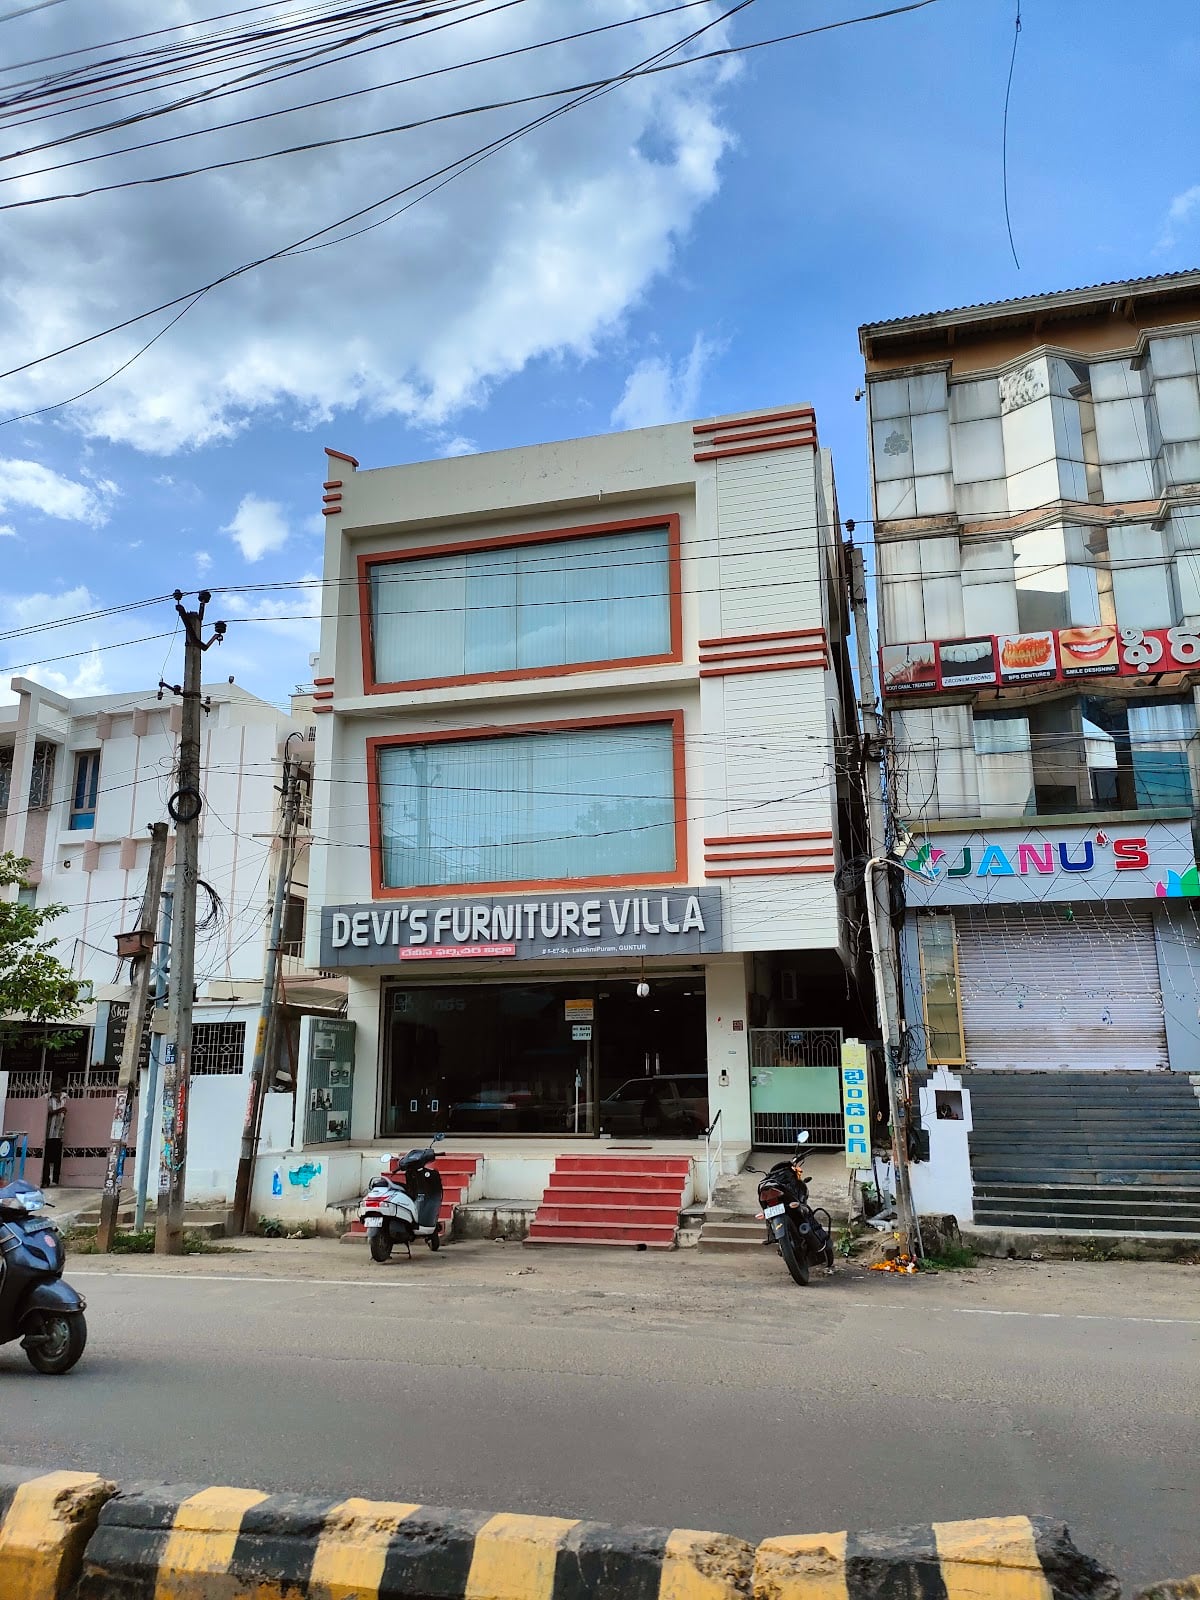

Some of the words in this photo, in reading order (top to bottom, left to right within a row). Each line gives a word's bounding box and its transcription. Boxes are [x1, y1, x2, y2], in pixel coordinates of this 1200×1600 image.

[912, 681, 936, 689] TREATMENT
[1020, 671, 1051, 679] DENTURES
[947, 829, 1151, 878] JANU'S
[332, 905, 428, 948] DEVI'S
[434, 900, 600, 943] FURNITURE
[608, 896, 706, 935] VILLA
